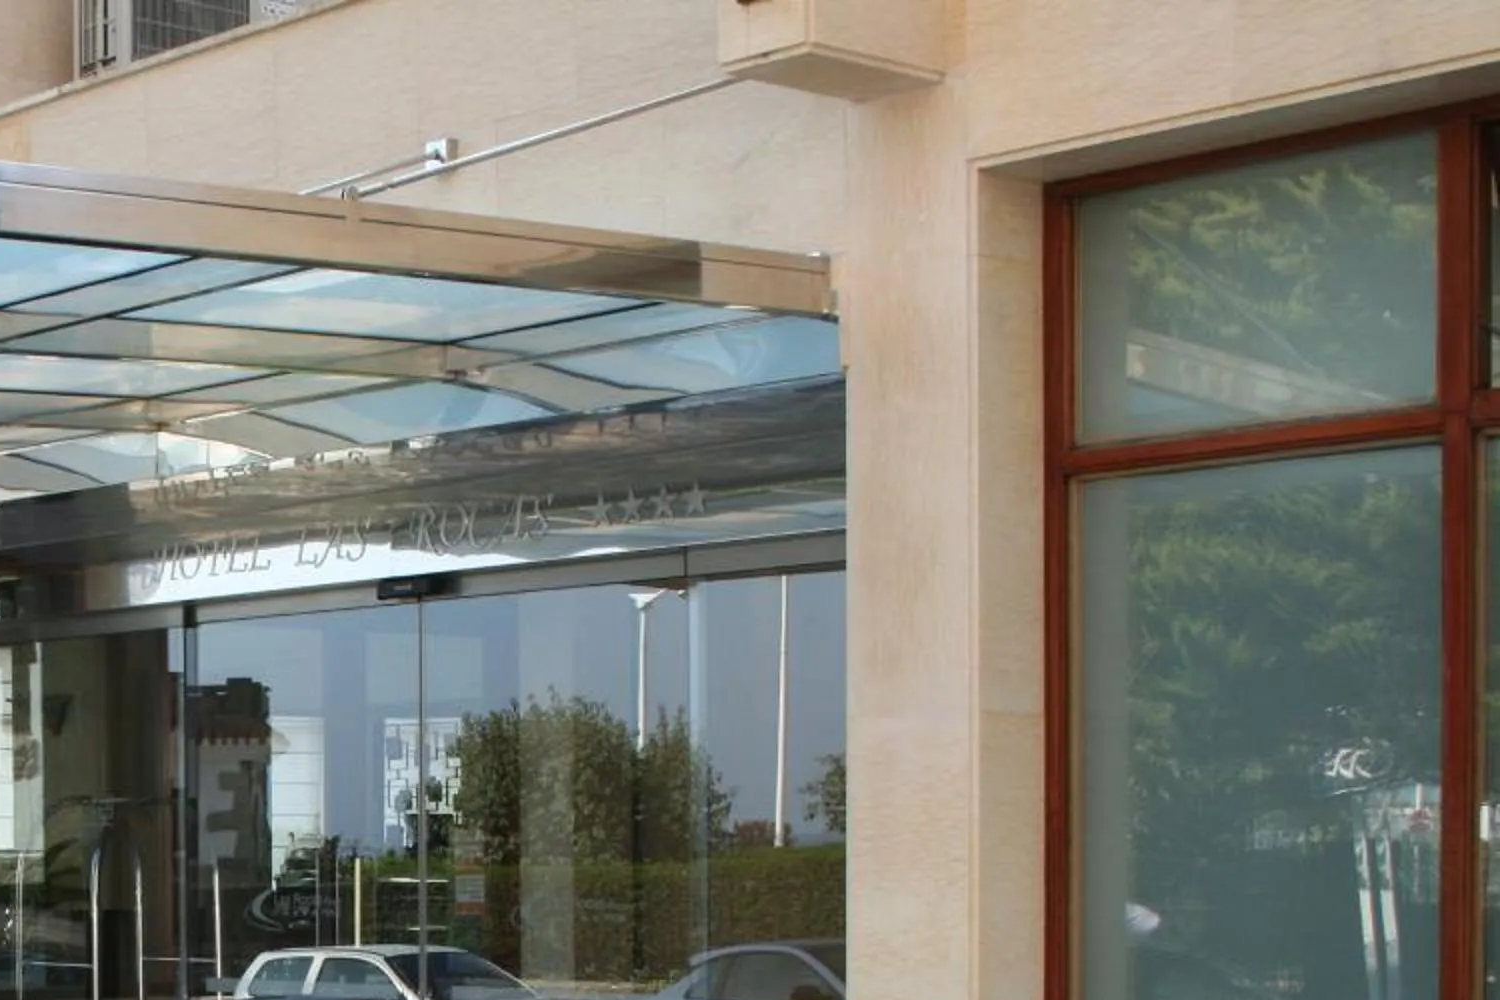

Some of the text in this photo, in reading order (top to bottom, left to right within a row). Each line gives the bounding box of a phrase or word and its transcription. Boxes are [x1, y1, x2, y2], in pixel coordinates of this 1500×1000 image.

[147, 493, 554, 586] HOTEL LAS ROCAS
